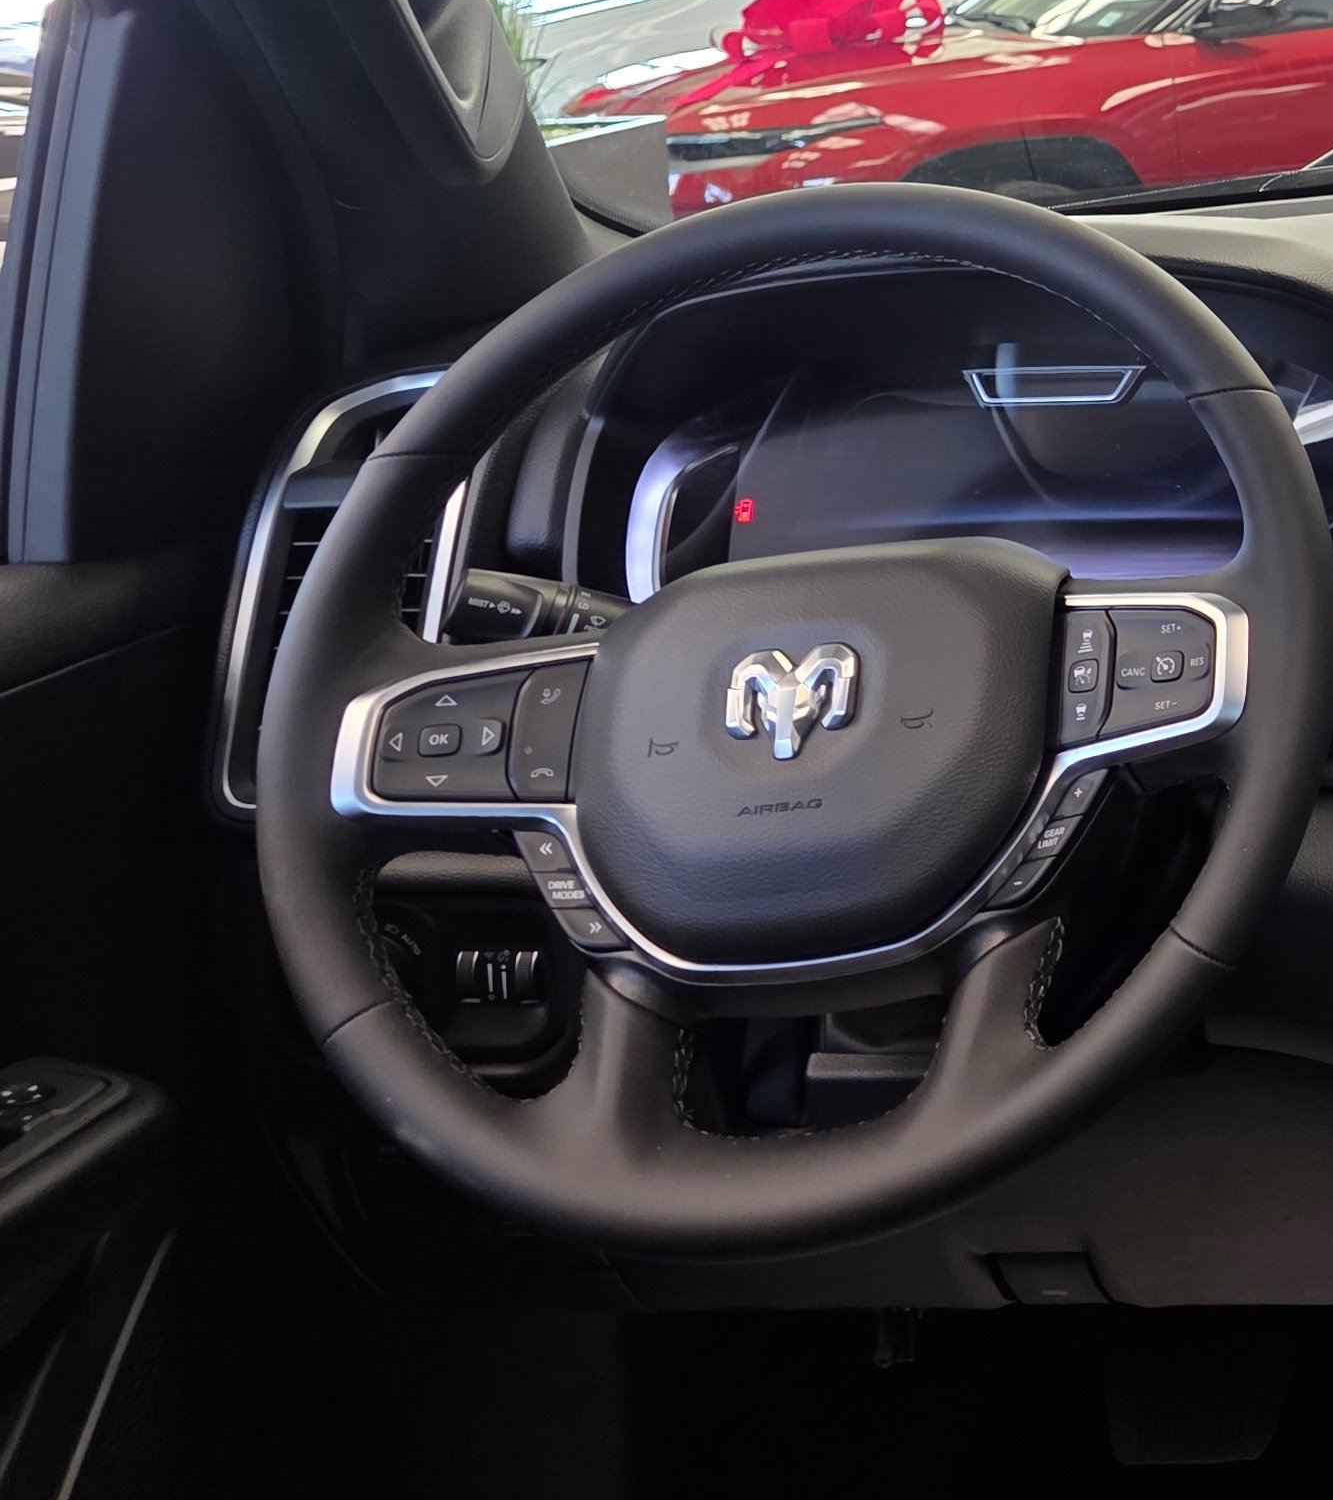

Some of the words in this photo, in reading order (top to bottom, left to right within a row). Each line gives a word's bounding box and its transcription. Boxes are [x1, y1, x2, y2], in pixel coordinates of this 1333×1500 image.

[468, 596, 489, 608] MIST
[1189, 656, 1205, 668] RES
[1120, 666, 1146, 678] CANC
[429, 733, 449, 746] OK
[736, 798, 824, 817] AIRBAG
[1043, 825, 1065, 838] GEAR
[1036, 837, 1060, 850] LIMIT
[547, 879, 576, 890] DRIVE
[551, 889, 586, 900] MODES
[400, 932, 422, 957] AUTO
